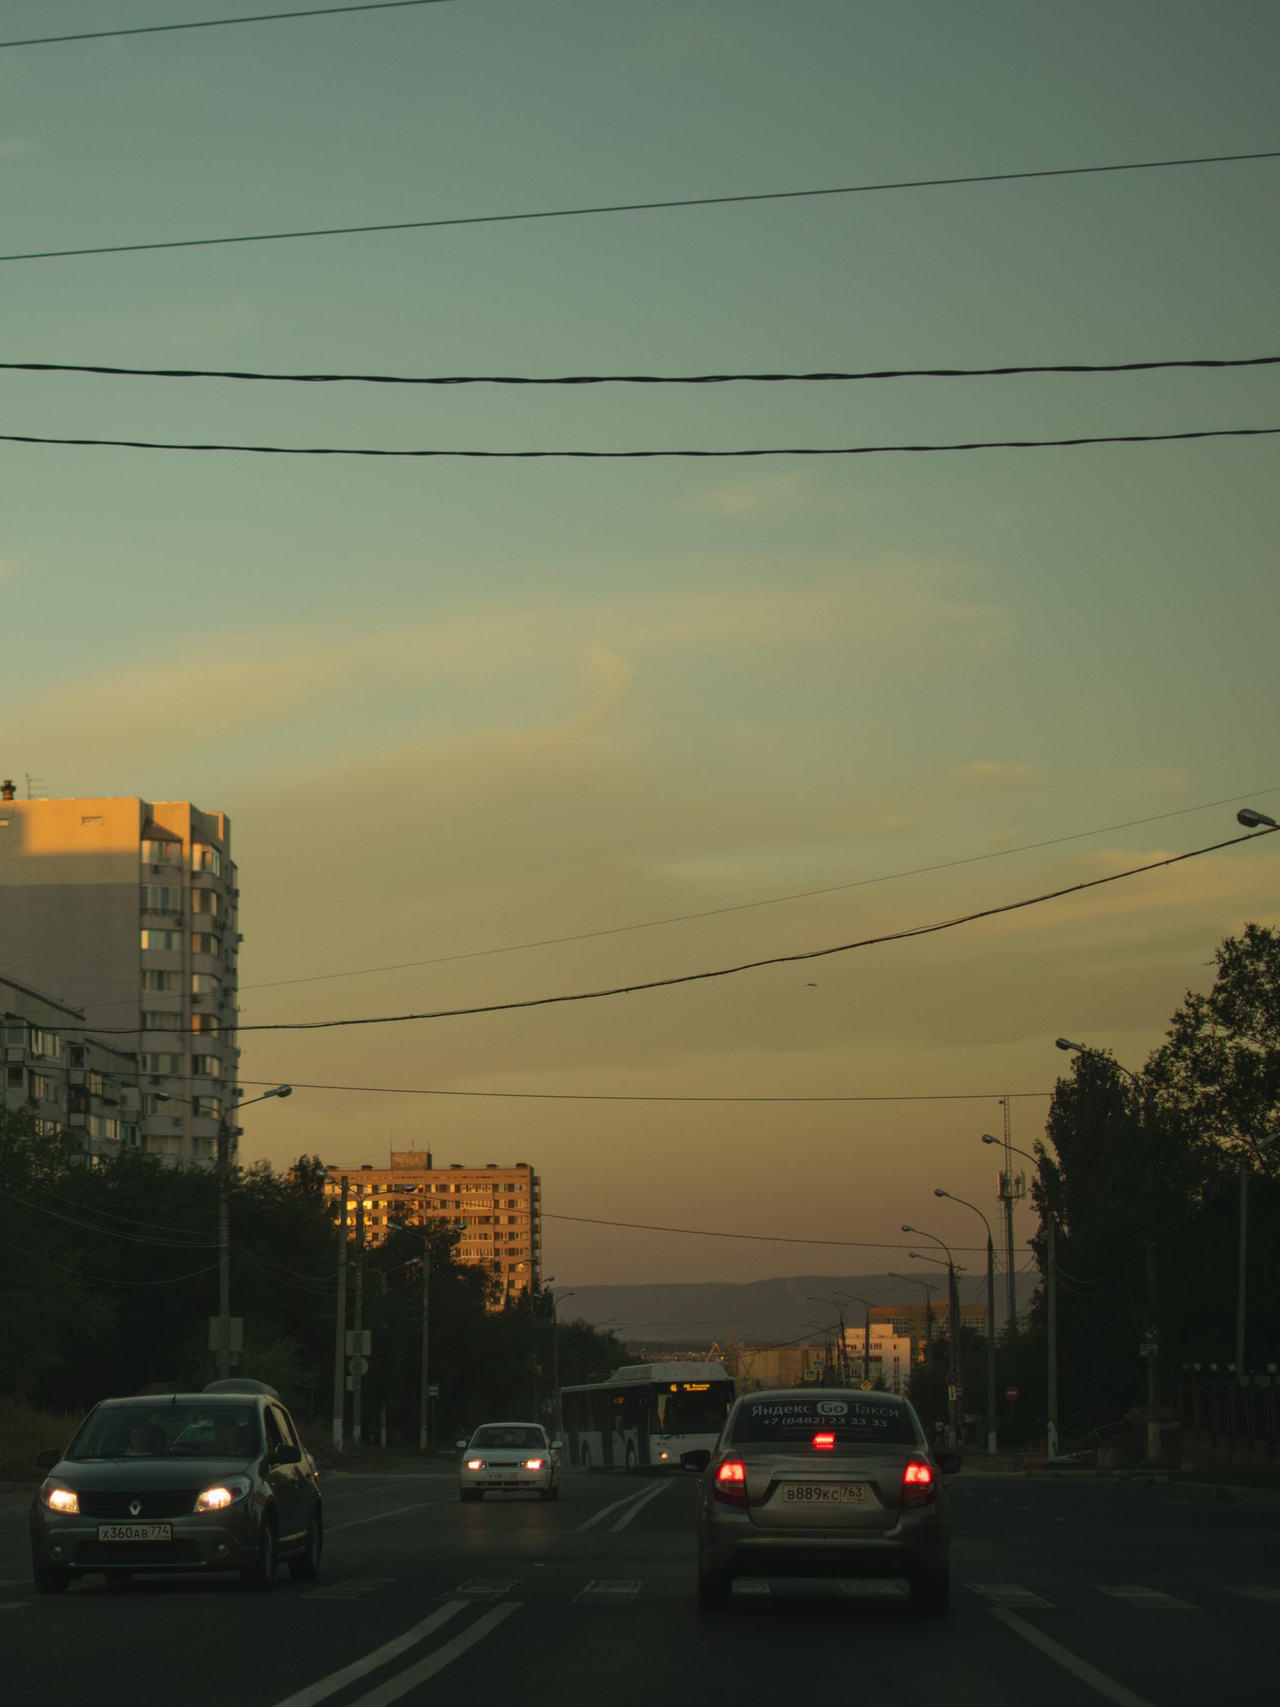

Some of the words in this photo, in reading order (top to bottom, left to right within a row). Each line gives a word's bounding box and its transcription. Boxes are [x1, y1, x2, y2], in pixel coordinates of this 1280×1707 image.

[751, 1404, 812, 1417] Яндекс
[820, 1402, 845, 1414] Go
[852, 1402, 899, 1418] Такси
[762, 1417, 779, 1426] +7
[782, 1416, 825, 1426] (8482)
[829, 1417, 846, 1425] 23
[851, 1417, 867, 1426] 33
[871, 1418, 888, 1427] 33
[787, 1487, 839, 1501] В889КС
[841, 1486, 862, 1497] 763
[102, 1527, 148, 1539] Х360АВ
[150, 1526, 169, 1535] 774
